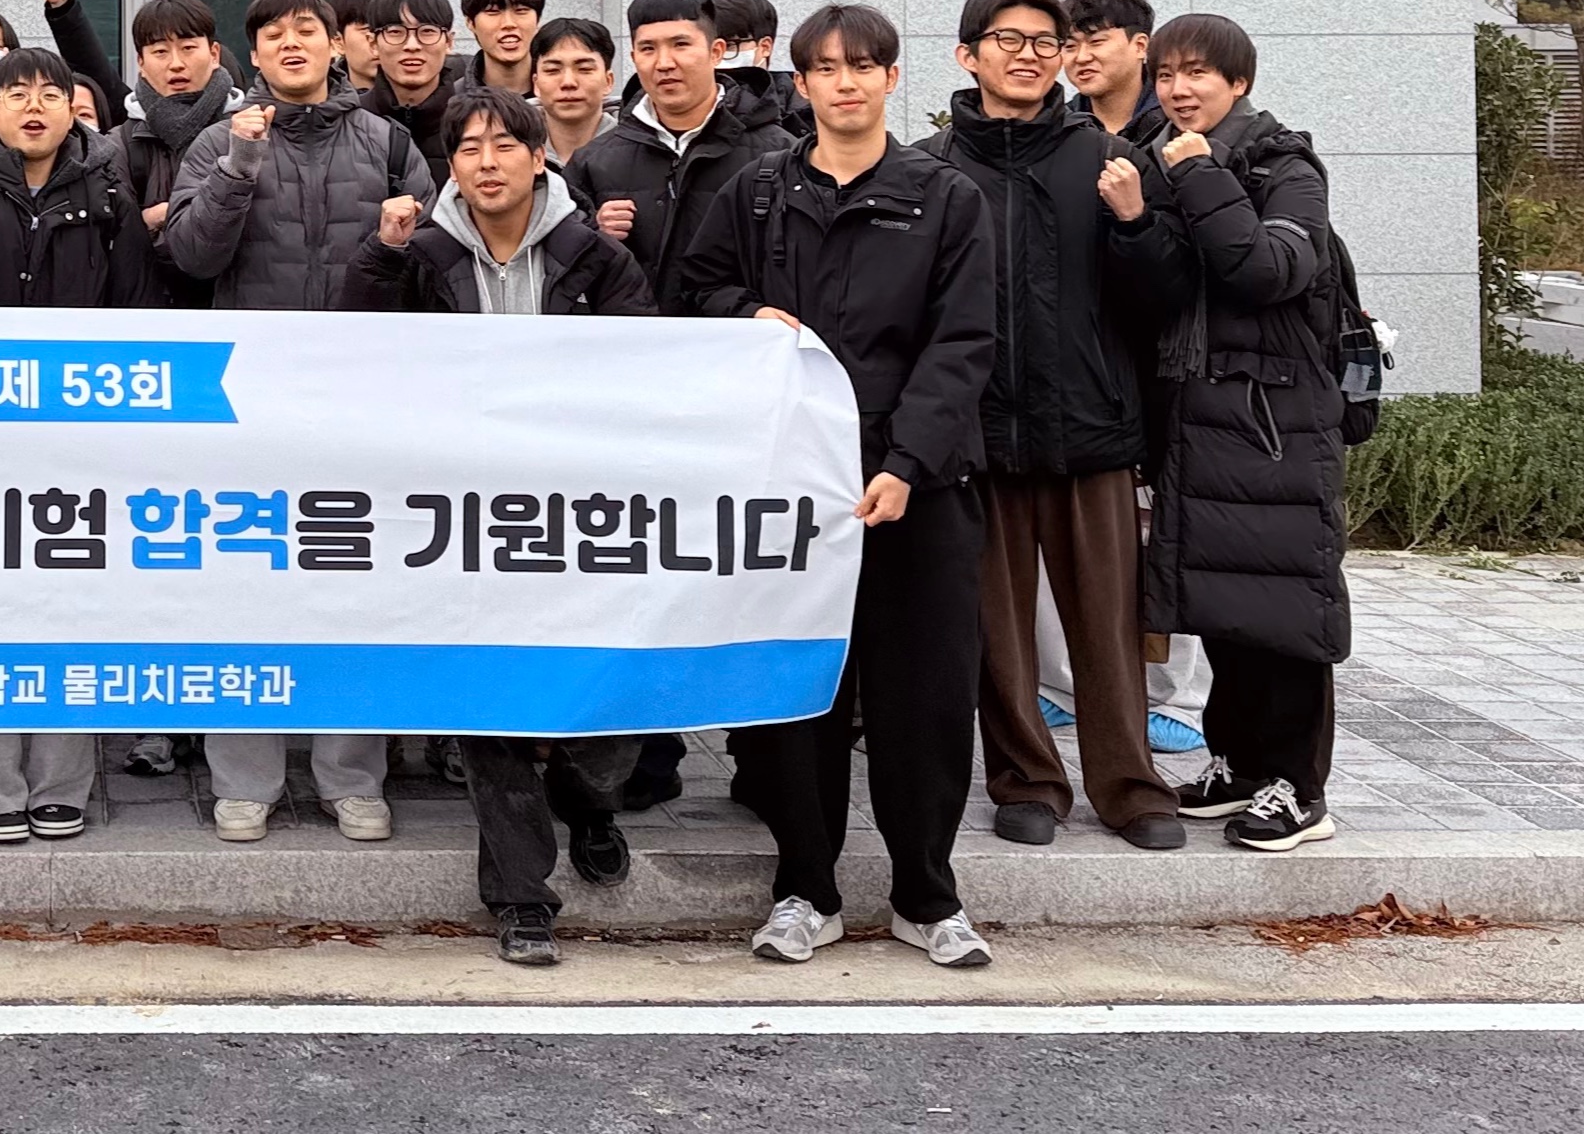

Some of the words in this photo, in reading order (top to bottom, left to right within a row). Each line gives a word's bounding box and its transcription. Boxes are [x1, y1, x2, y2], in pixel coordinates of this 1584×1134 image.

[62, 359, 172, 410] 53회
[125, 488, 375, 571] 합격을
[404, 491, 821, 576] 기원합니다
[63, 664, 296, 706] 물리치료학과
